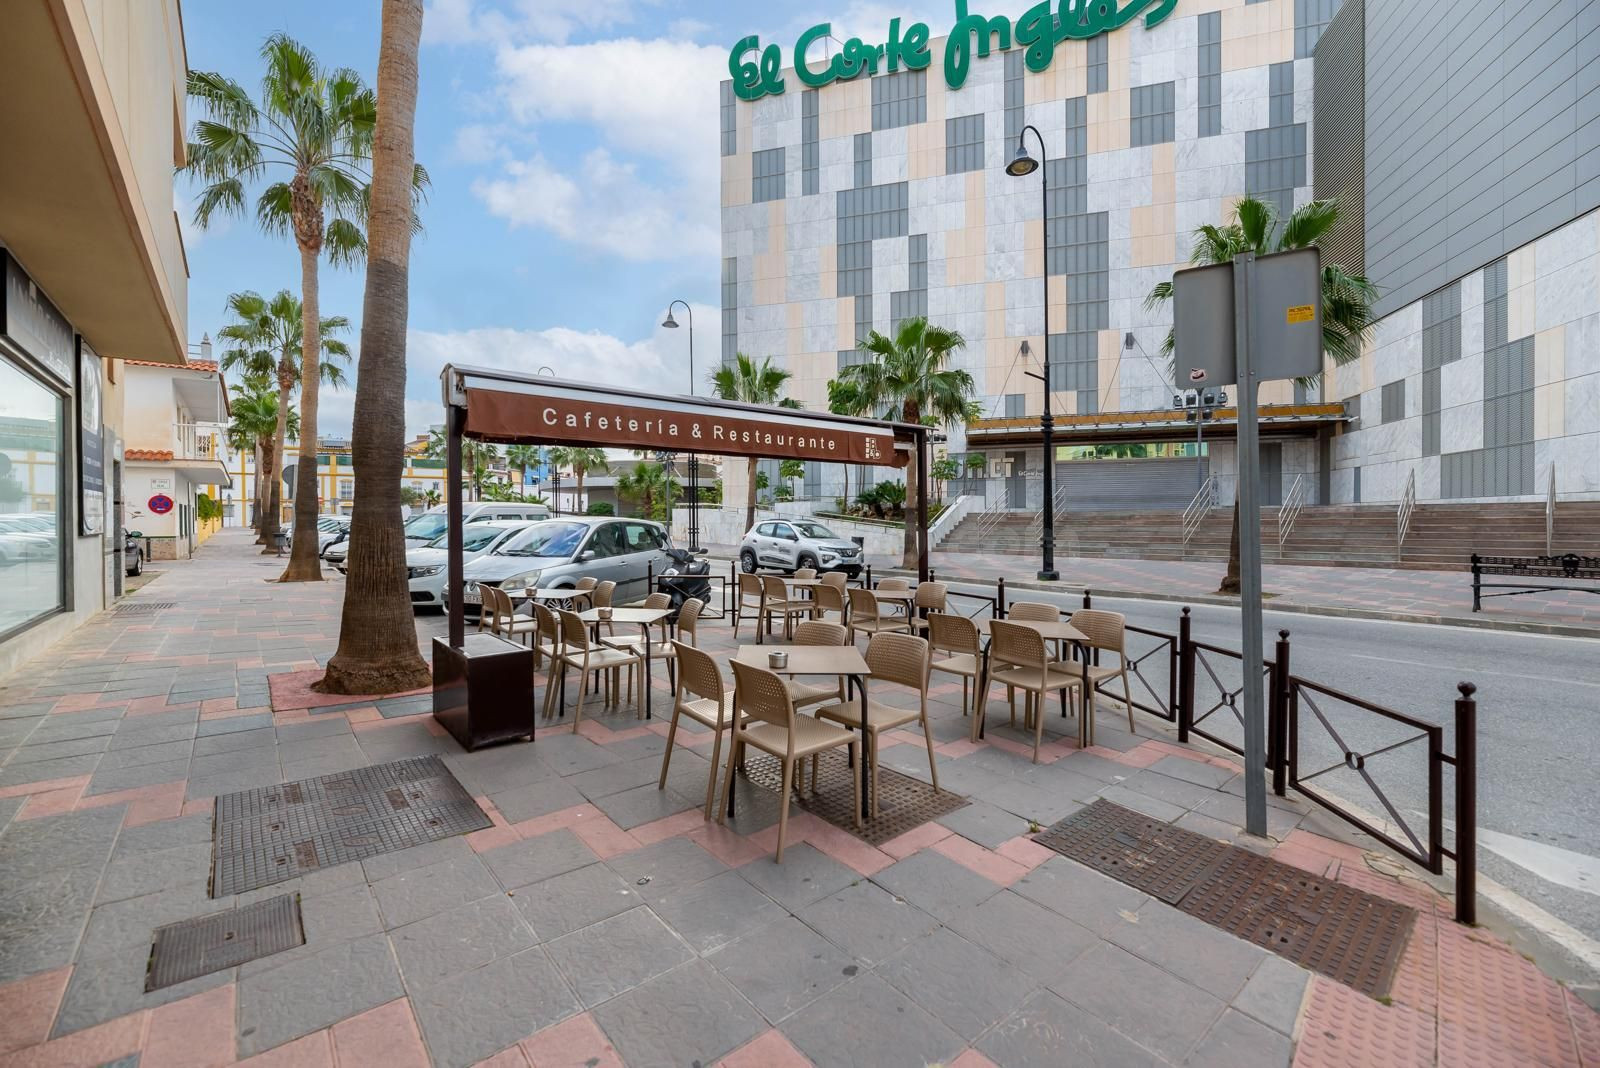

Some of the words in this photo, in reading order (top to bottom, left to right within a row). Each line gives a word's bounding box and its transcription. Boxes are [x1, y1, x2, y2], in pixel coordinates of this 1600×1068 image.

[728, 35, 786, 101] El
[794, 17, 932, 88] Corte
[542, 407, 679, 436] Cafetería
[691, 422, 703, 439] &
[713, 425, 836, 450] Restaurante
